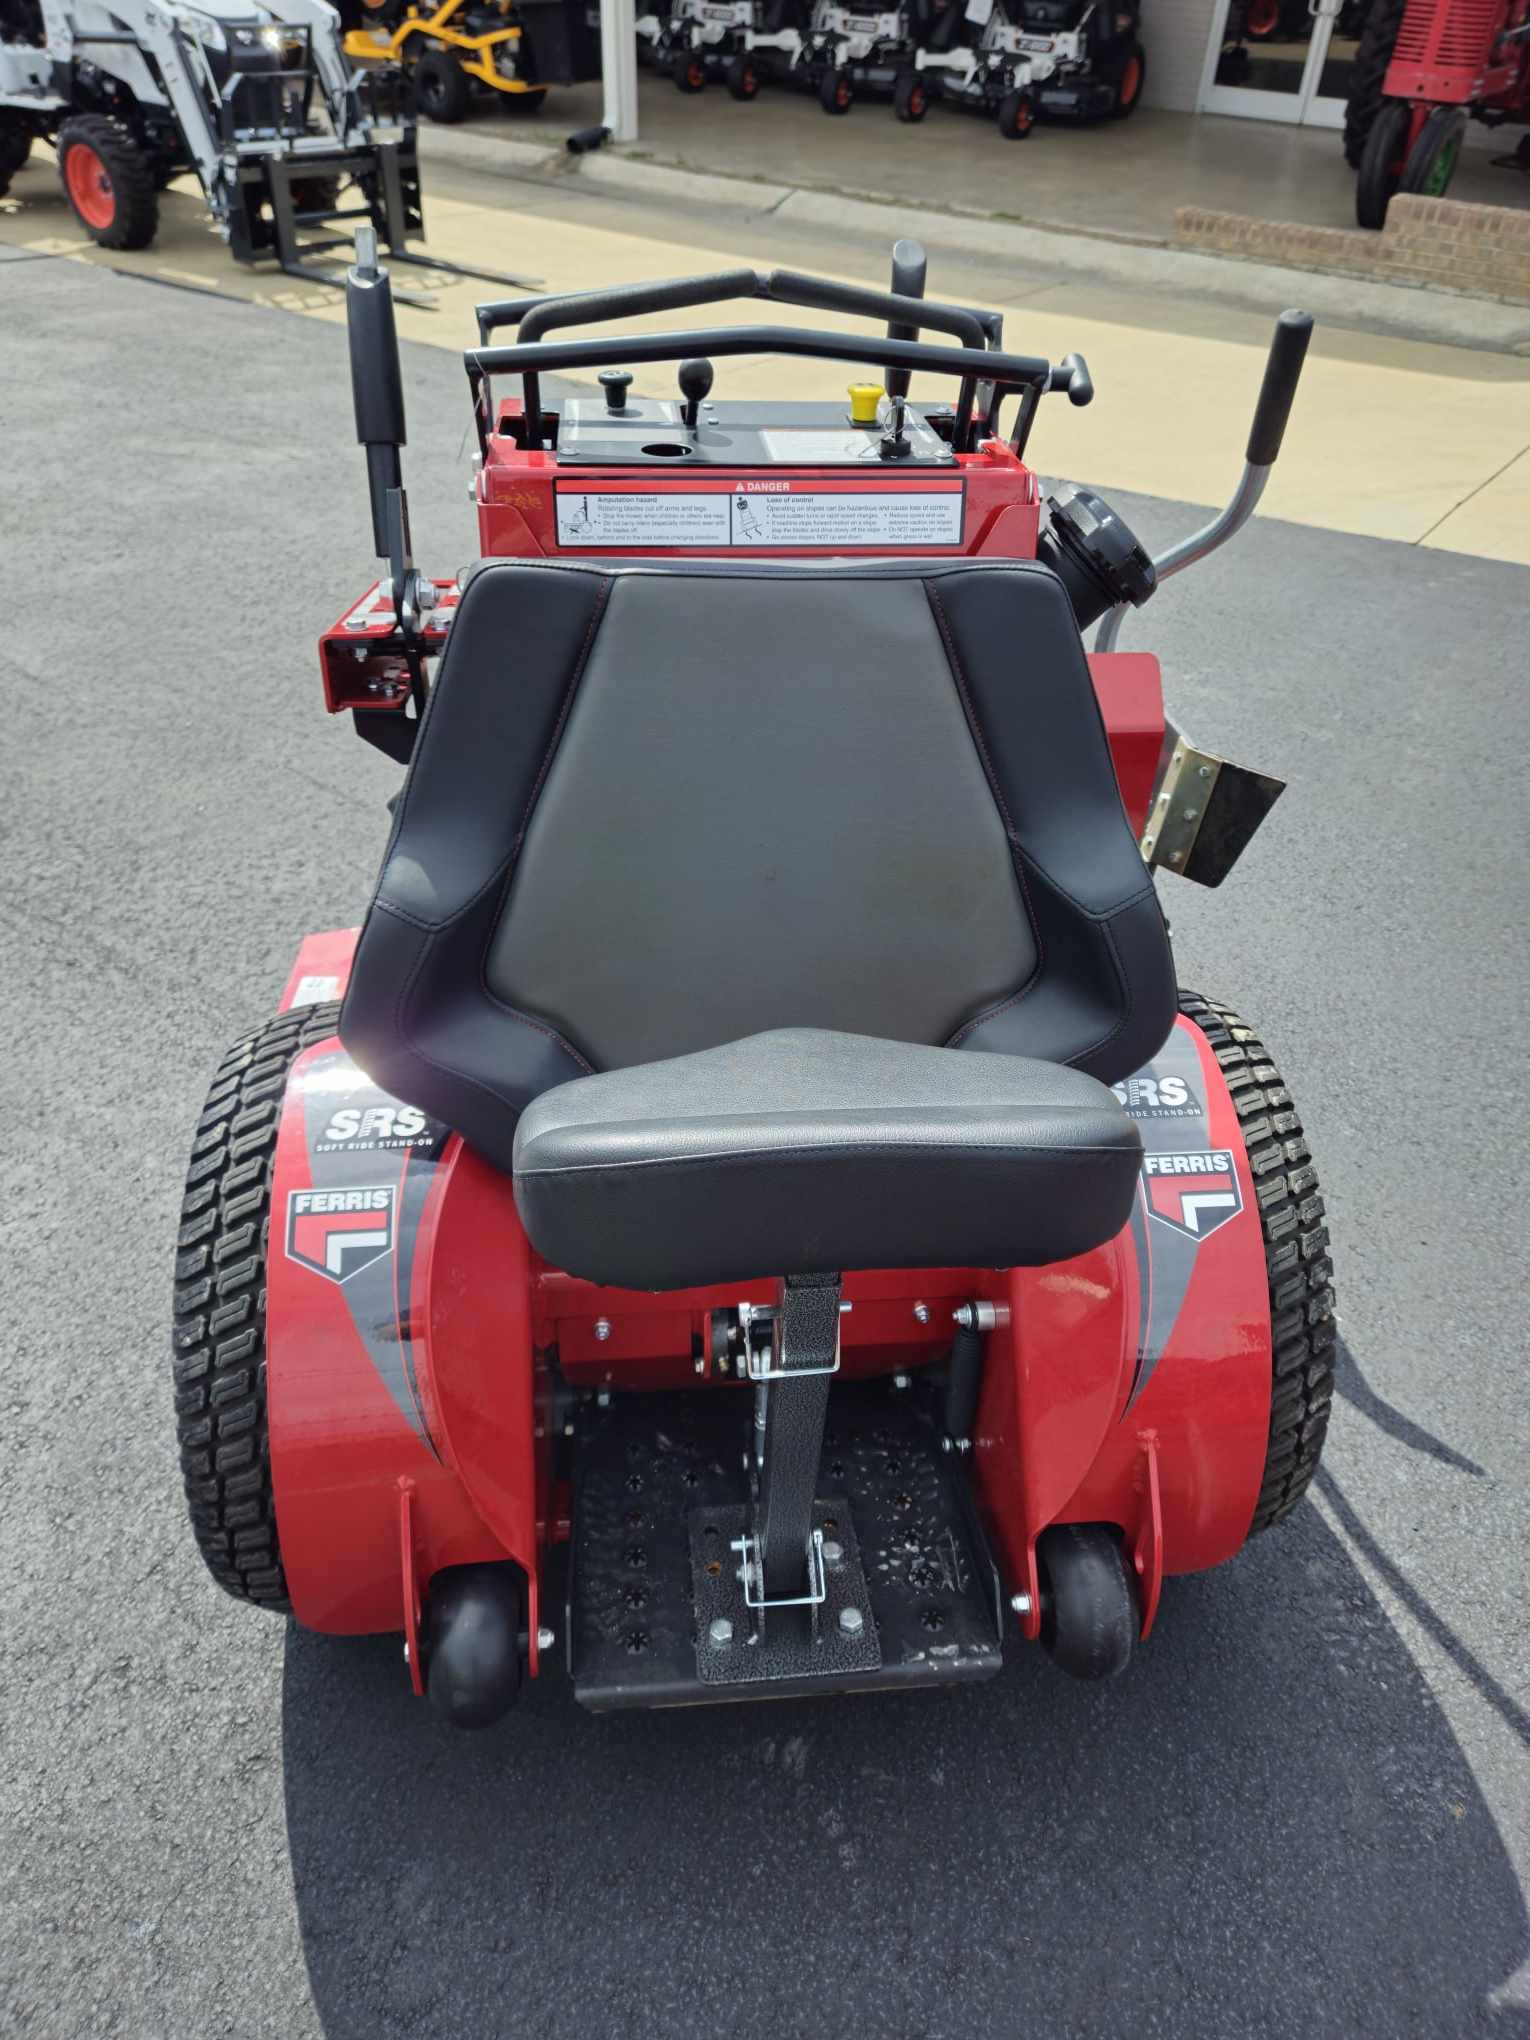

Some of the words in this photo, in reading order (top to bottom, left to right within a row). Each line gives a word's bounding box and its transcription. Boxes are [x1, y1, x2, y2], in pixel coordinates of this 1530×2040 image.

[747, 482, 790, 491] DANGER
[1152, 1109, 1201, 1117] STAND-ON
[325, 1105, 426, 1140] SRS
[316, 1143, 344, 1152] SOFT
[347, 1141, 374, 1150] RIDE
[378, 1138, 433, 1149] STAND-ON
[1144, 1154, 1229, 1174] FERRIS
[295, 1190, 389, 1213] FERRIS
